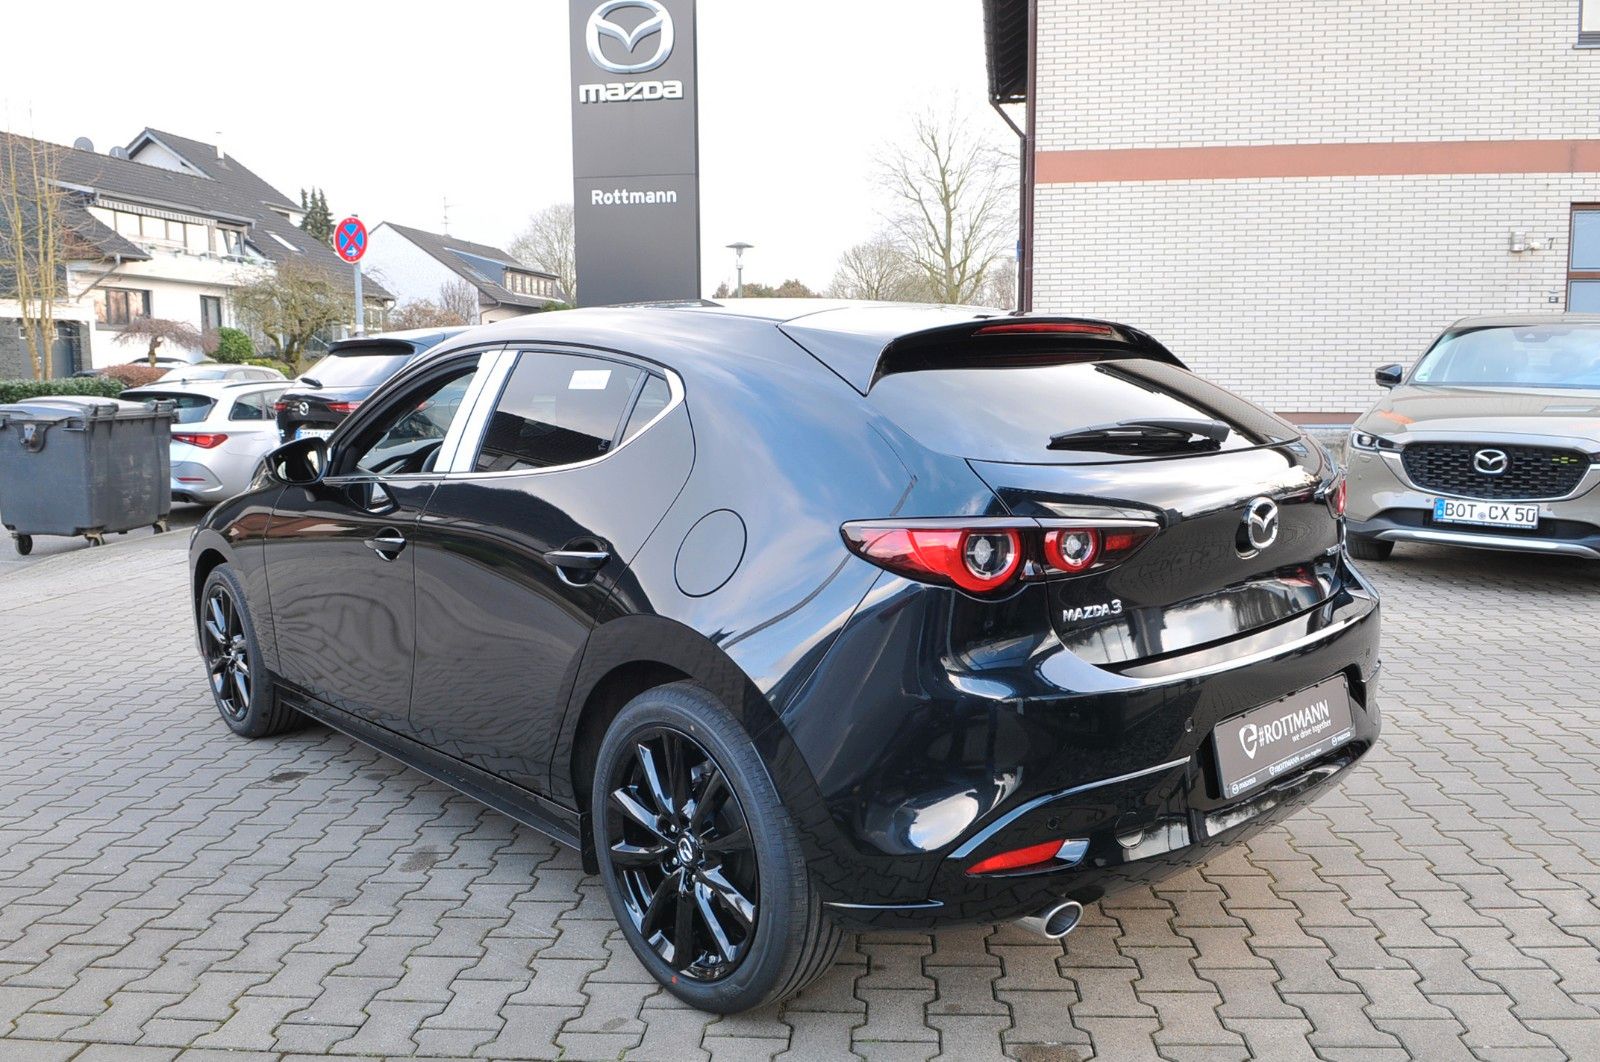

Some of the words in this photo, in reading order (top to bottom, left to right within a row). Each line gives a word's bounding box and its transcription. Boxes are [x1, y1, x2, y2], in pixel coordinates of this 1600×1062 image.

[591, 189, 677, 206] Rottmann
[1547, 237, 1555, 250] 7
[1445, 502, 1477, 518] BOT
[1488, 505, 1510, 521] CX
[1515, 508, 1536, 523] 50
